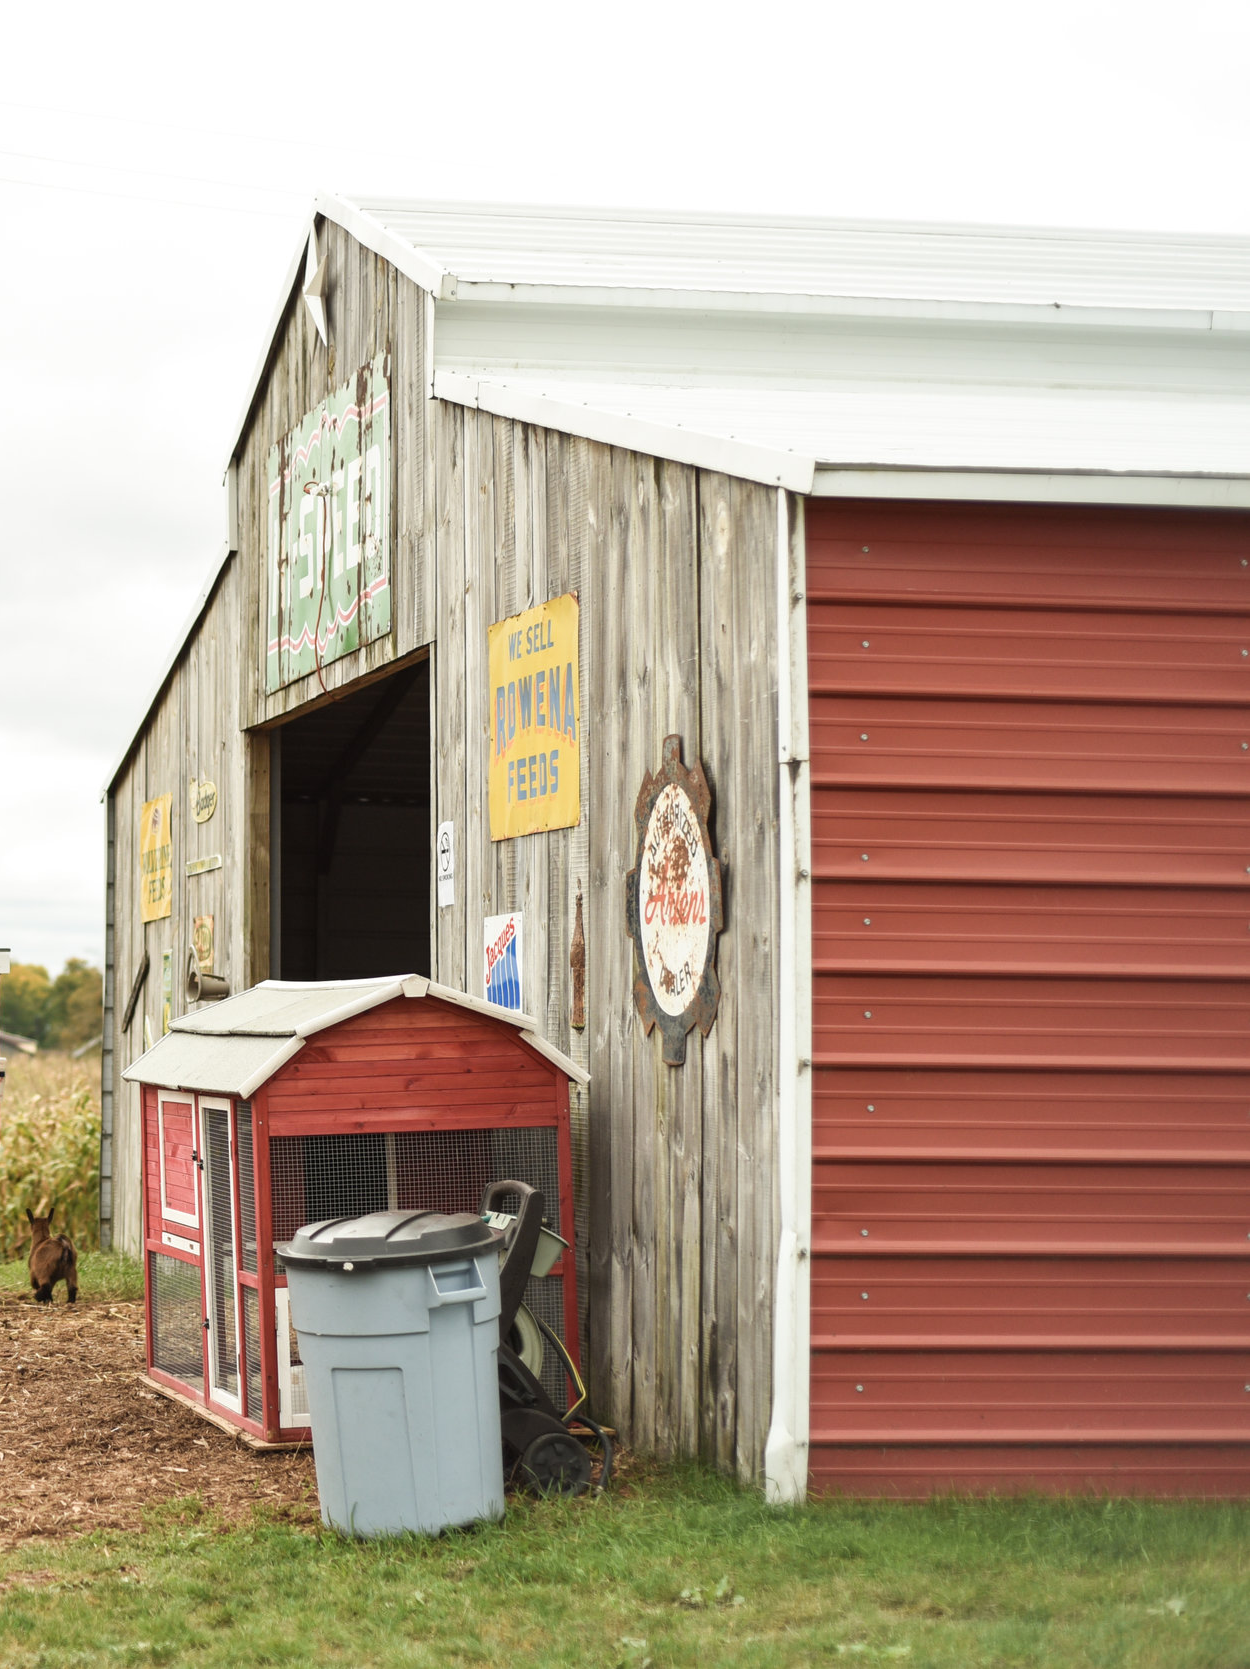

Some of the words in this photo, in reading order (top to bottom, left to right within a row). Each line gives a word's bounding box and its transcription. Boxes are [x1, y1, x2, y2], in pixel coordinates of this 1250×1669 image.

[508, 630, 523, 662] WE
[526, 619, 554, 655] SELL
[495, 662, 576, 763] ROWENA
[508, 749, 559, 804] FEEDS
[645, 862, 707, 926] Ariens
[486, 915, 515, 985] Jacques
[660, 961, 692, 997] DALER
